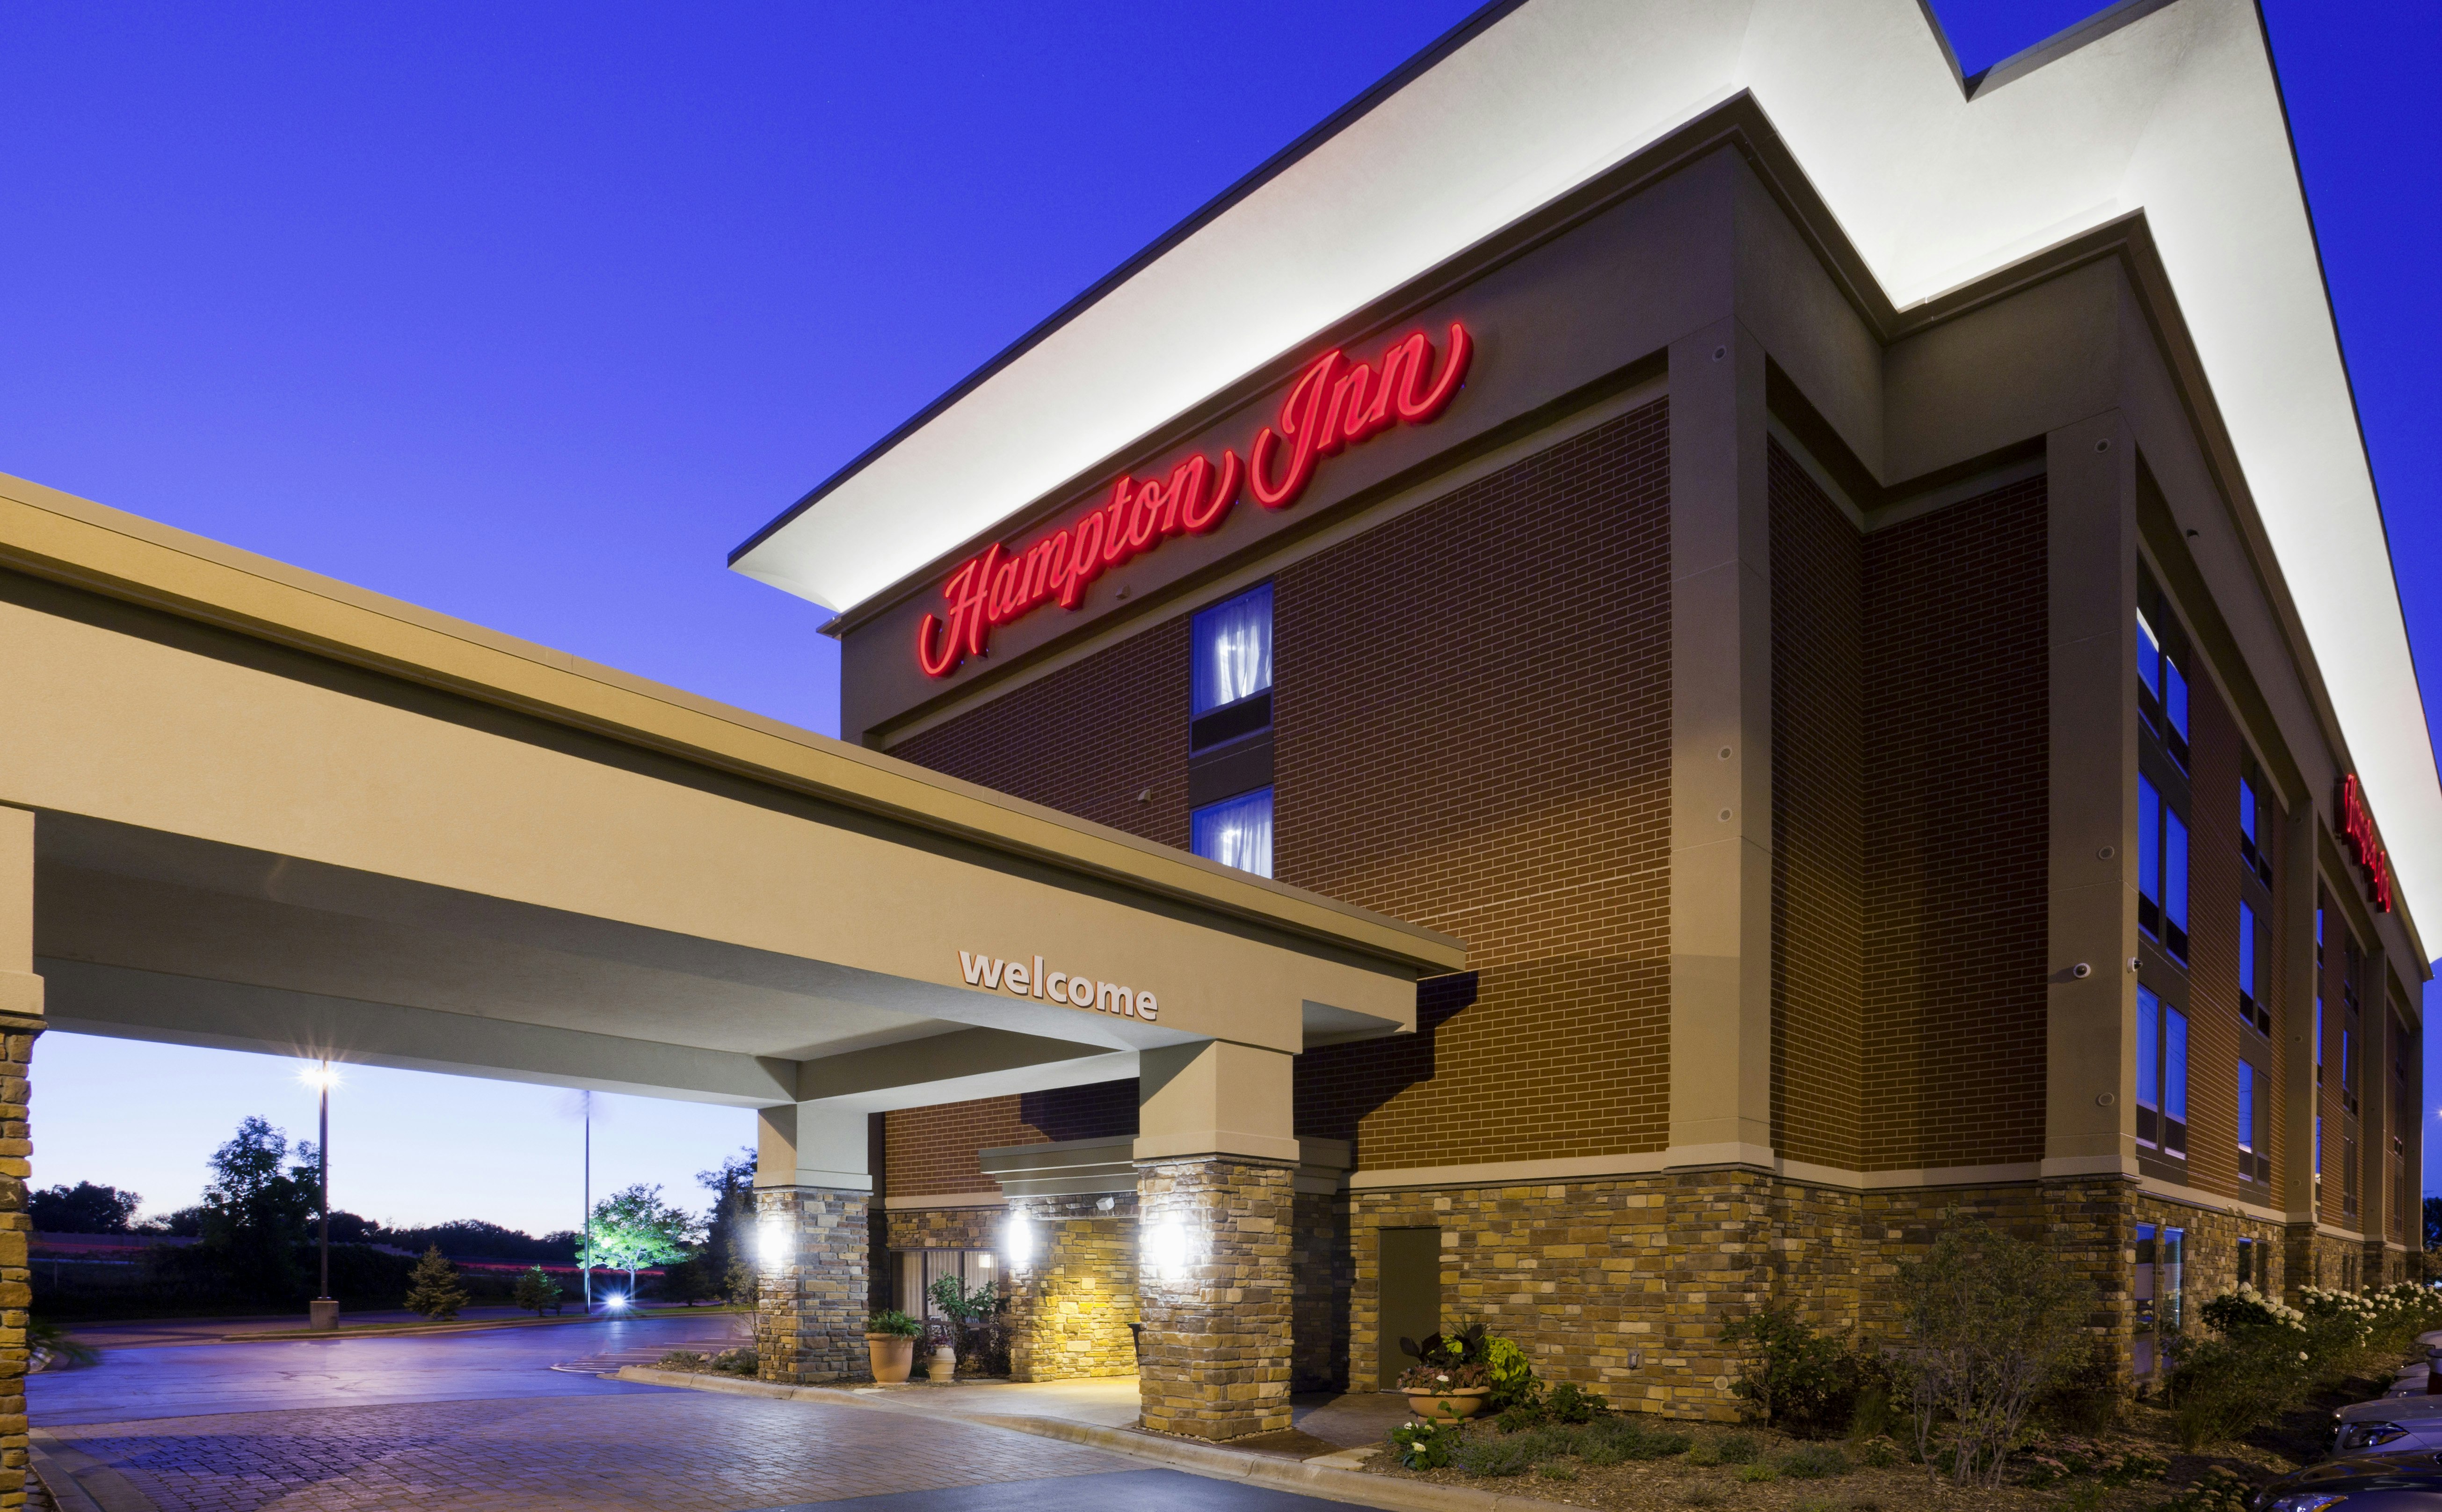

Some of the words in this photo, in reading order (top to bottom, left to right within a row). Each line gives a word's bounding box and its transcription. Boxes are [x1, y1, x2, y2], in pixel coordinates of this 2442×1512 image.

[919, 450, 1244, 676] Hampton
[1250, 322, 1473, 506] Inn
[958, 950, 1158, 1021] welcome
